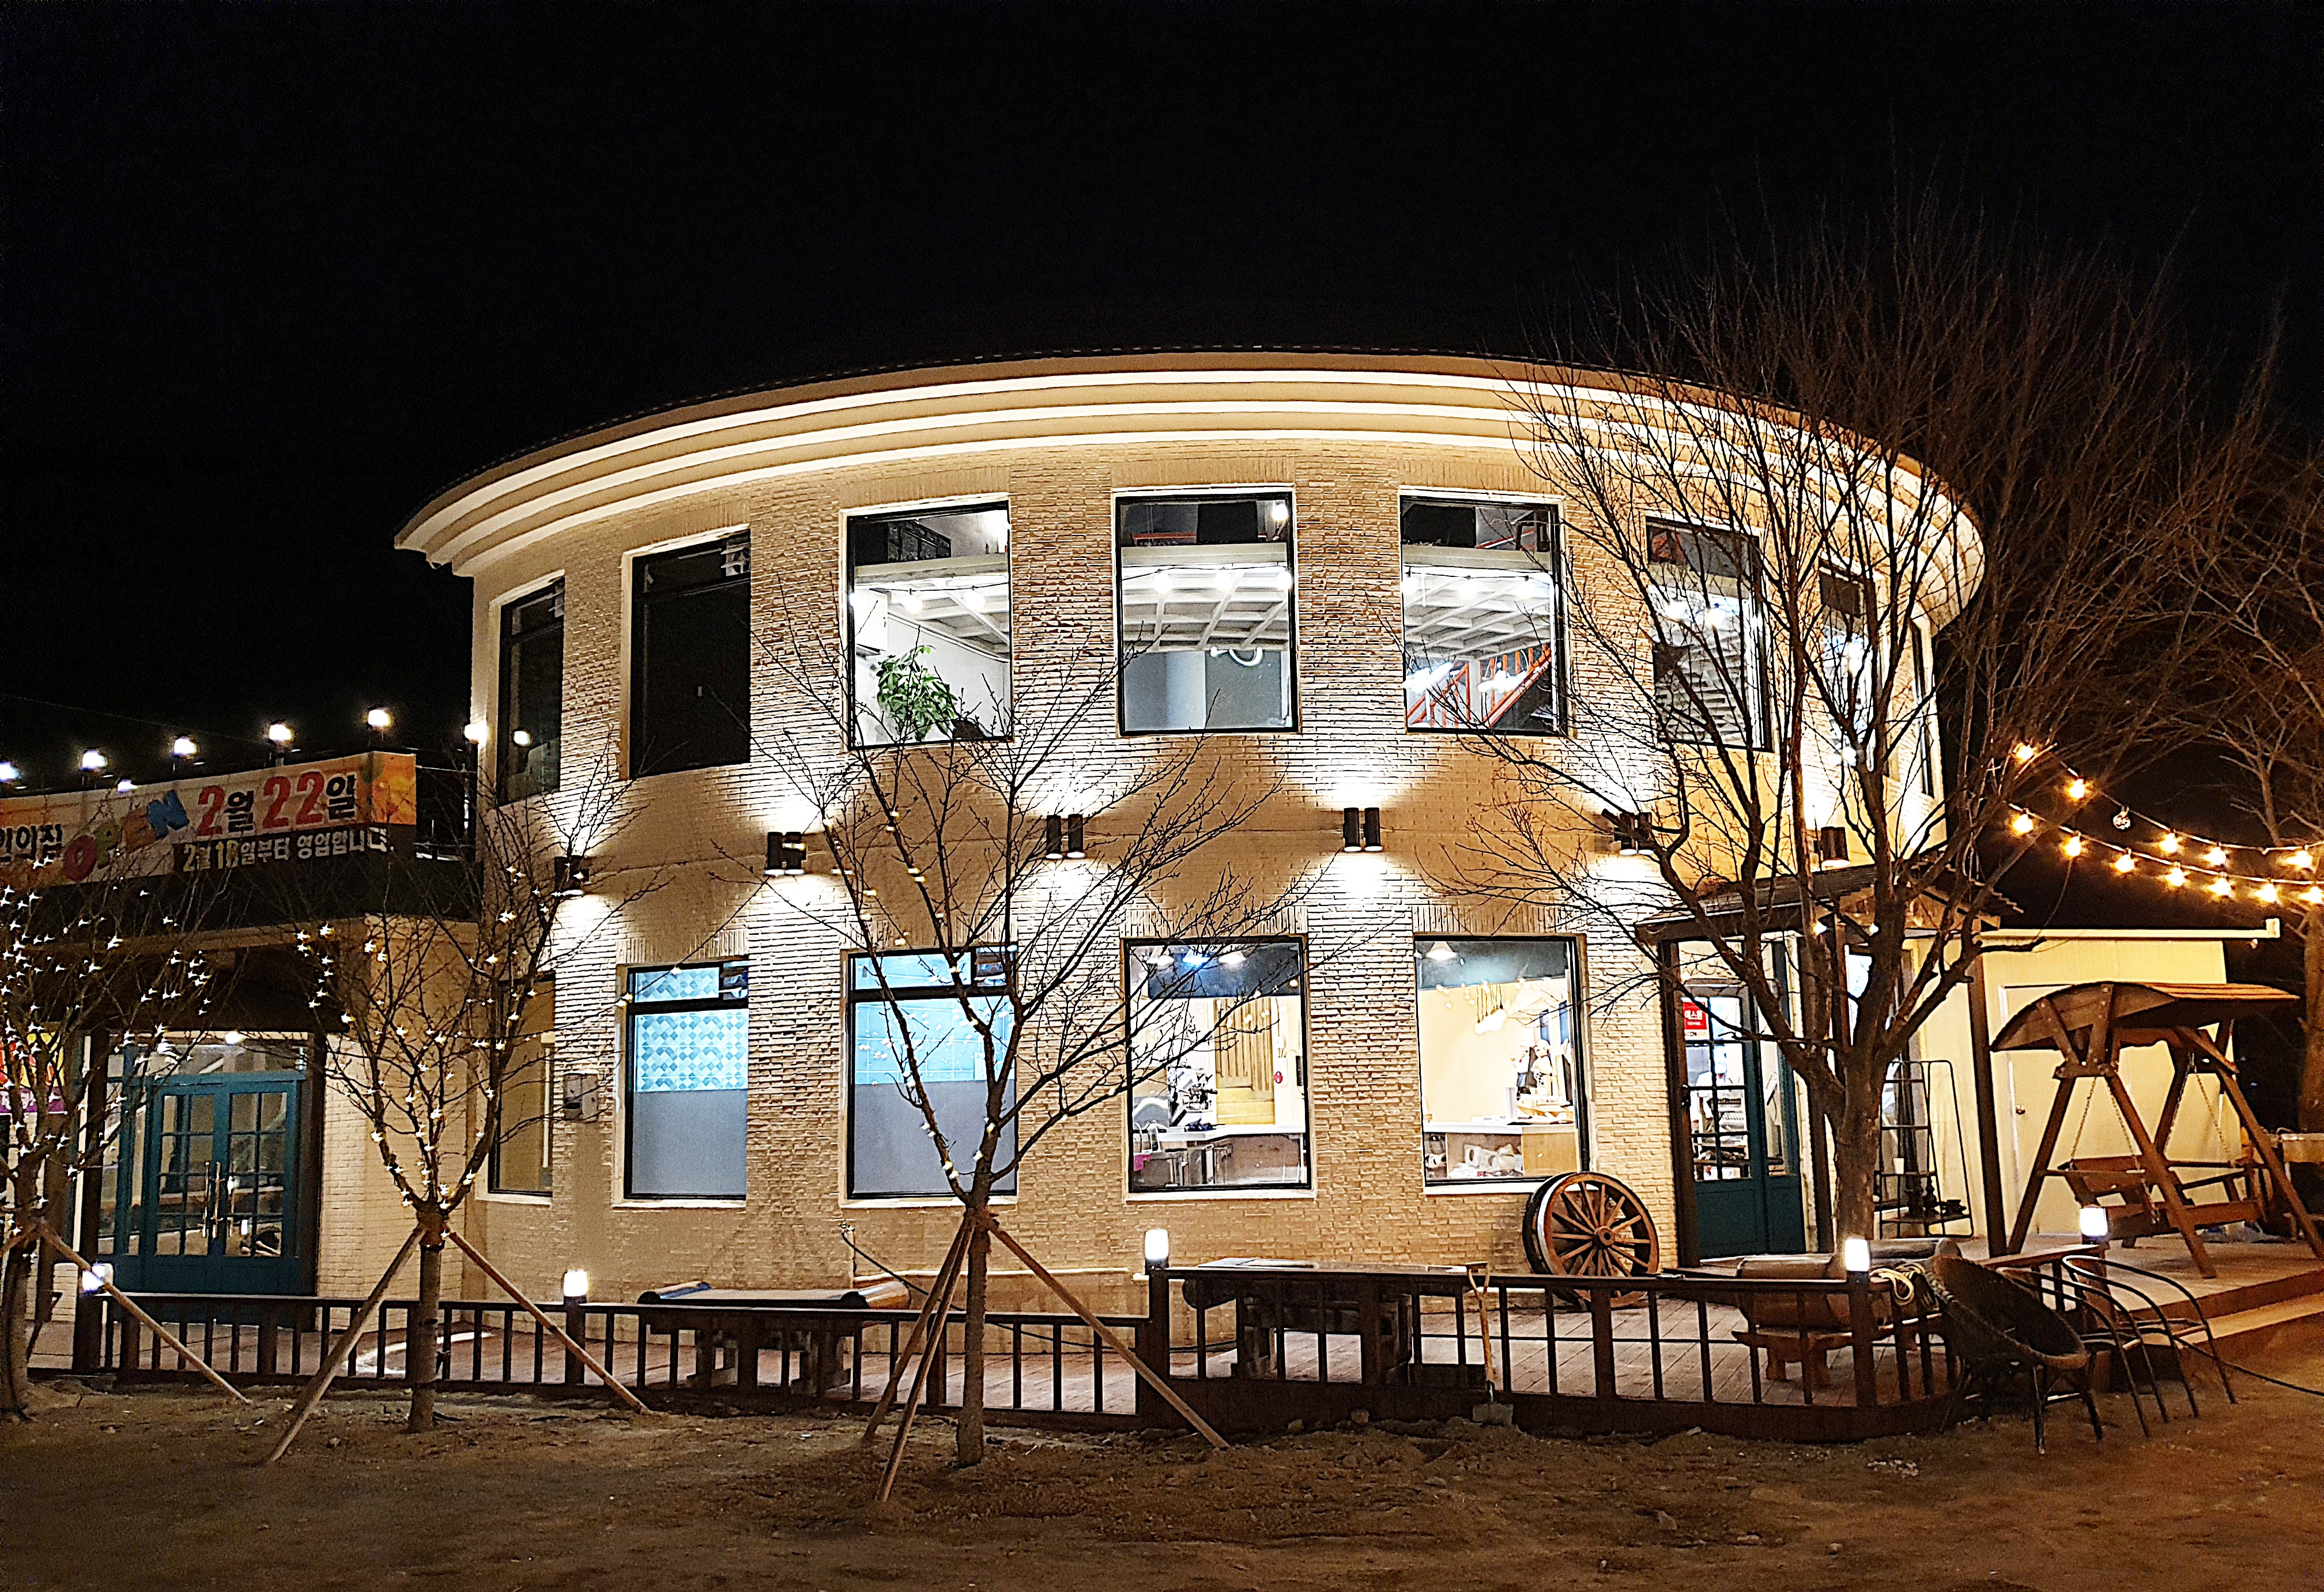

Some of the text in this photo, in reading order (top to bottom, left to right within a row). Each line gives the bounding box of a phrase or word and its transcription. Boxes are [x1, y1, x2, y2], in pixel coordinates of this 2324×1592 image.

[63, 789, 190, 882] OPEN
[197, 784, 255, 836] 2월
[262, 771, 357, 830] 22일
